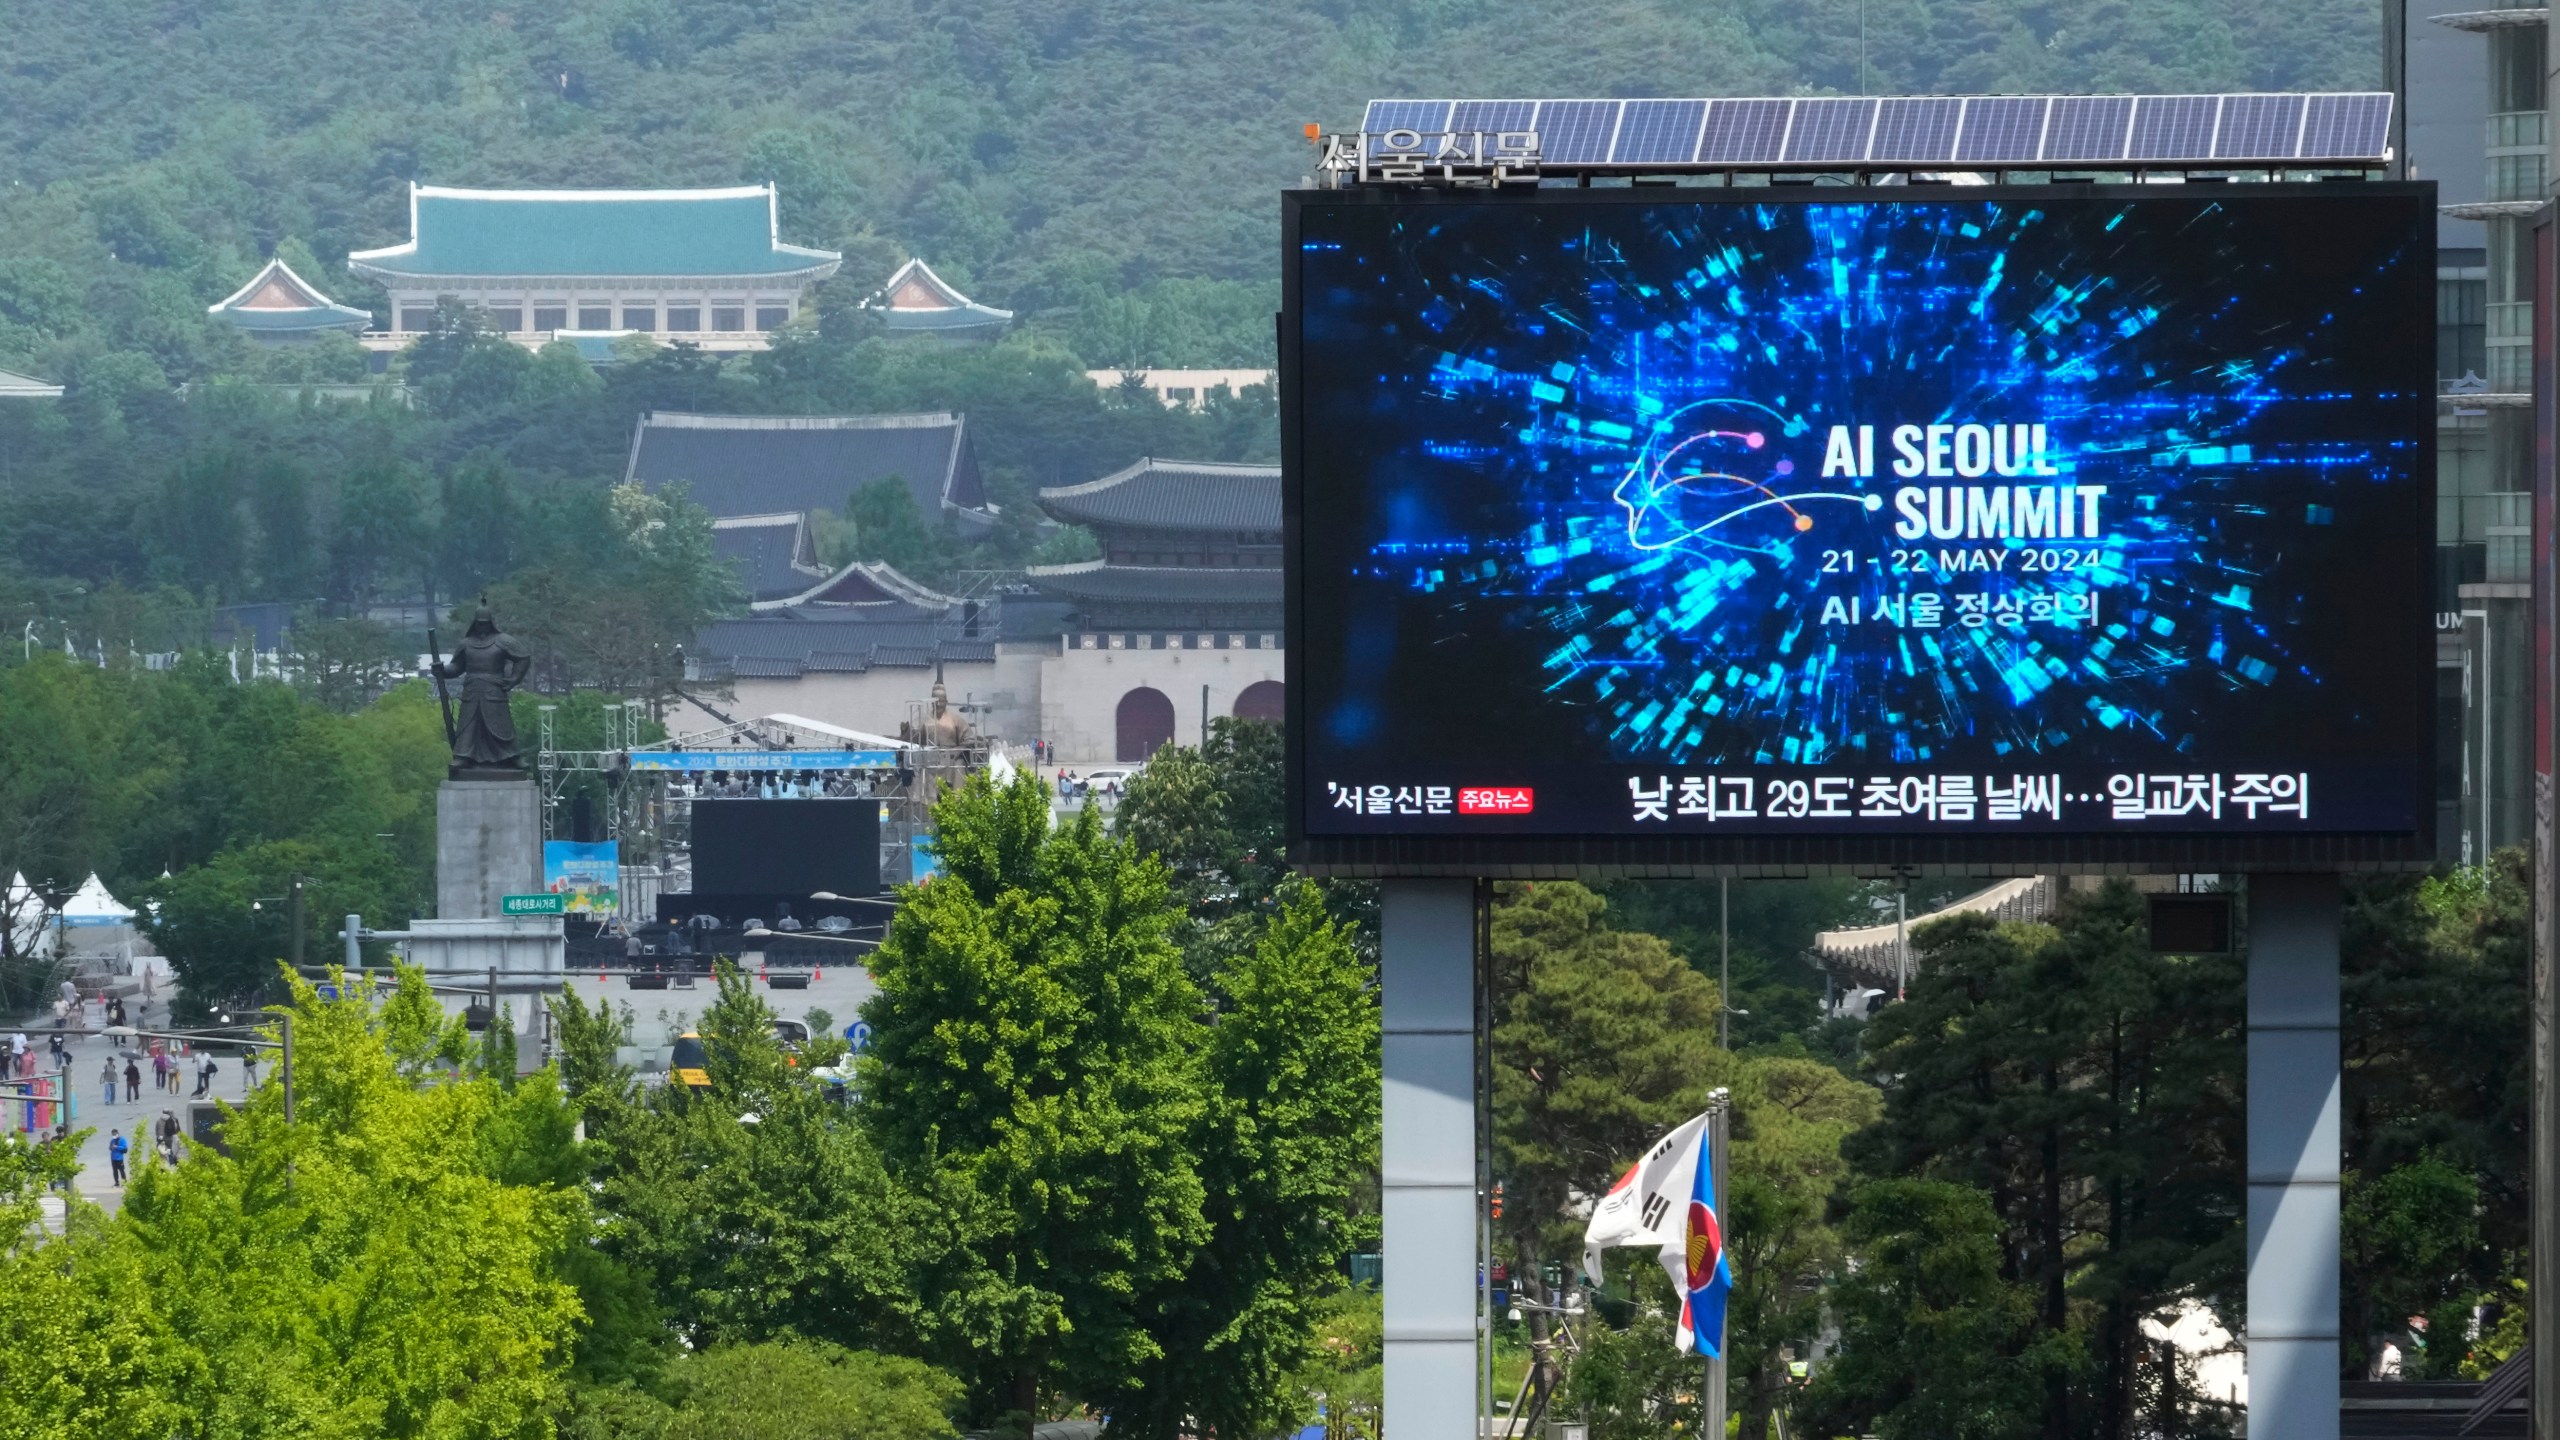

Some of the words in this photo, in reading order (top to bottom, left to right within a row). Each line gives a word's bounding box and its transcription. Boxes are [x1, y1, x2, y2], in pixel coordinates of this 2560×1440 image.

[1315, 129, 1543, 183] 서울신문
[1821, 425, 1874, 478] AI
[1892, 423, 2058, 478] SEOUL
[1894, 485, 2108, 540] SUMMIT
[1821, 549, 1854, 573] 21
[1891, 549, 1927, 573] 22
[1939, 548, 2010, 573] MAY
[2020, 548, 2101, 572] 2024
[1820, 596, 1860, 625] AI
[1871, 592, 1945, 628] 서울
[1954, 591, 2099, 628] 정상회의
[1461, 790, 1530, 809] 주요뉴스
[1676, 775, 1758, 822] 최고
[1858, 774, 1979, 821] 초여름
[2229, 772, 2309, 820] 주의
[508, 898, 557, 911] 세종대로사거리
